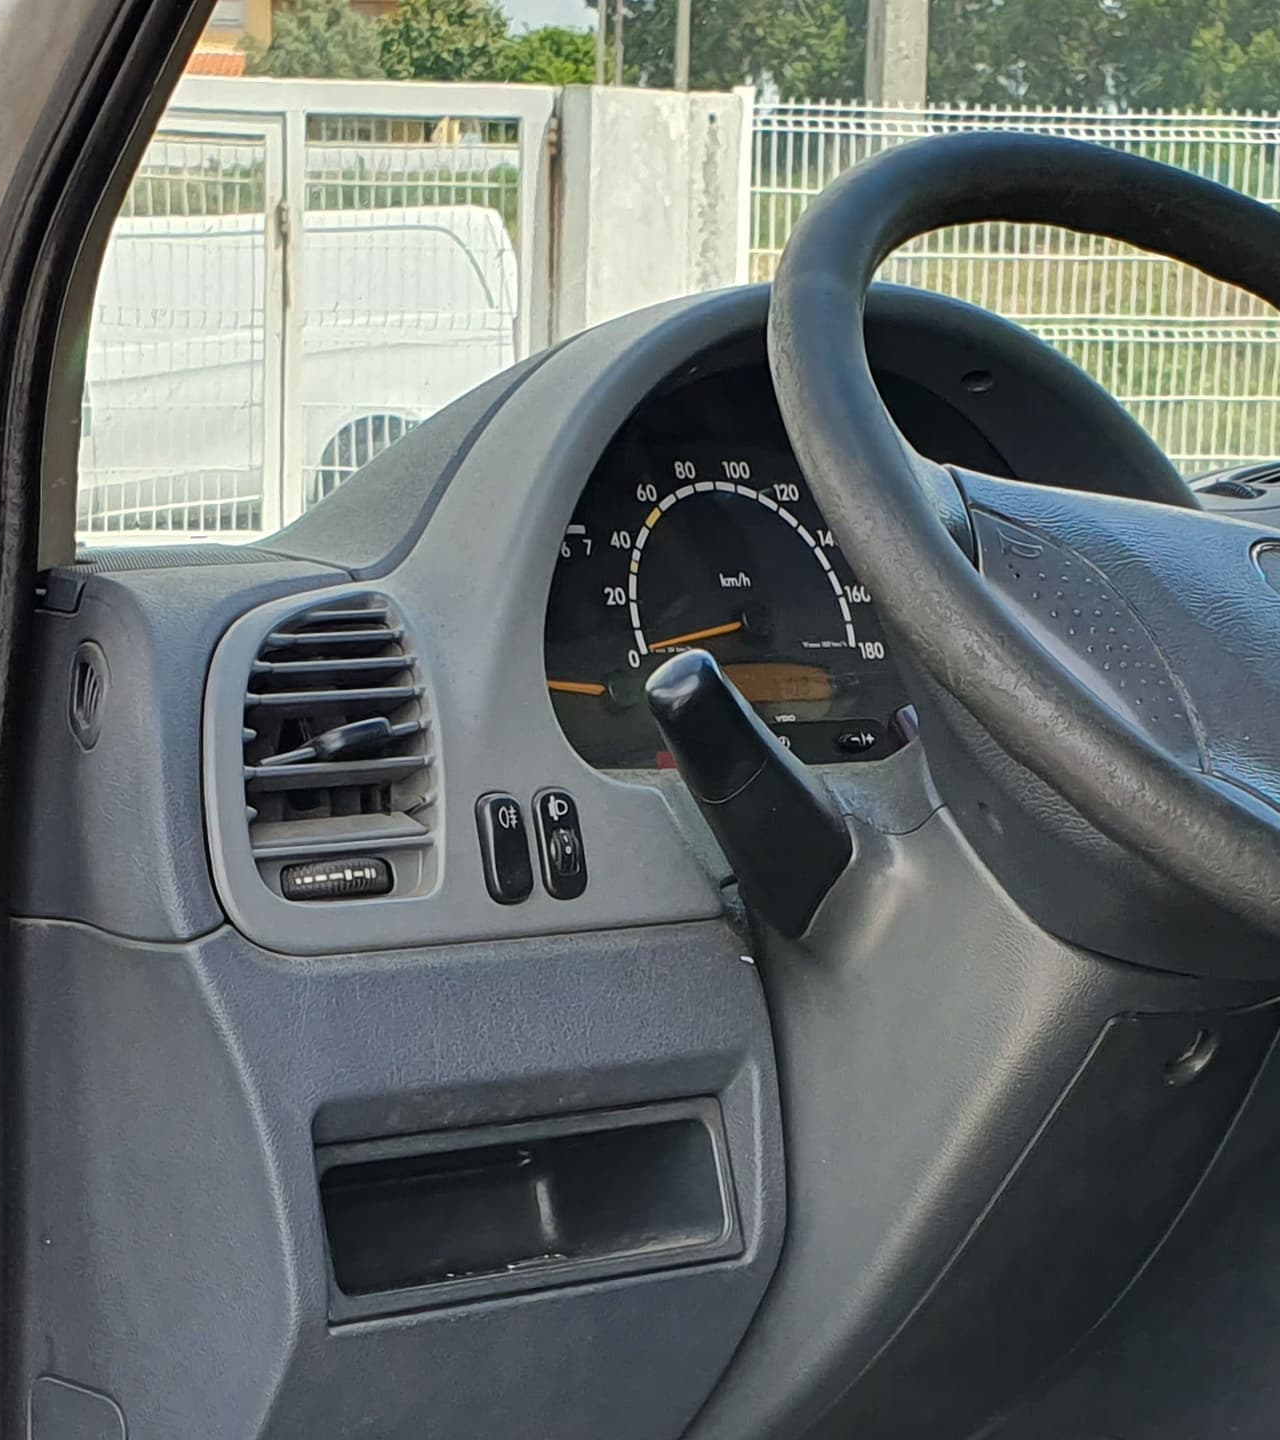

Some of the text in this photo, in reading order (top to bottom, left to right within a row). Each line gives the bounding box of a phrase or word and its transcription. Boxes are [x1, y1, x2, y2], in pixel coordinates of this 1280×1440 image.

[674, 461, 696, 480] 80
[722, 461, 751, 480] 100
[636, 483, 658, 502] 60
[773, 483, 799, 502] 120
[582, 539, 592, 556] 7
[610, 530, 631, 549] 40
[816, 530, 837, 547] 14
[719, 571, 751, 588] km/h
[604, 586, 626, 605] 20
[628, 651, 640, 668] 0
[858, 642, 885, 660] 180
